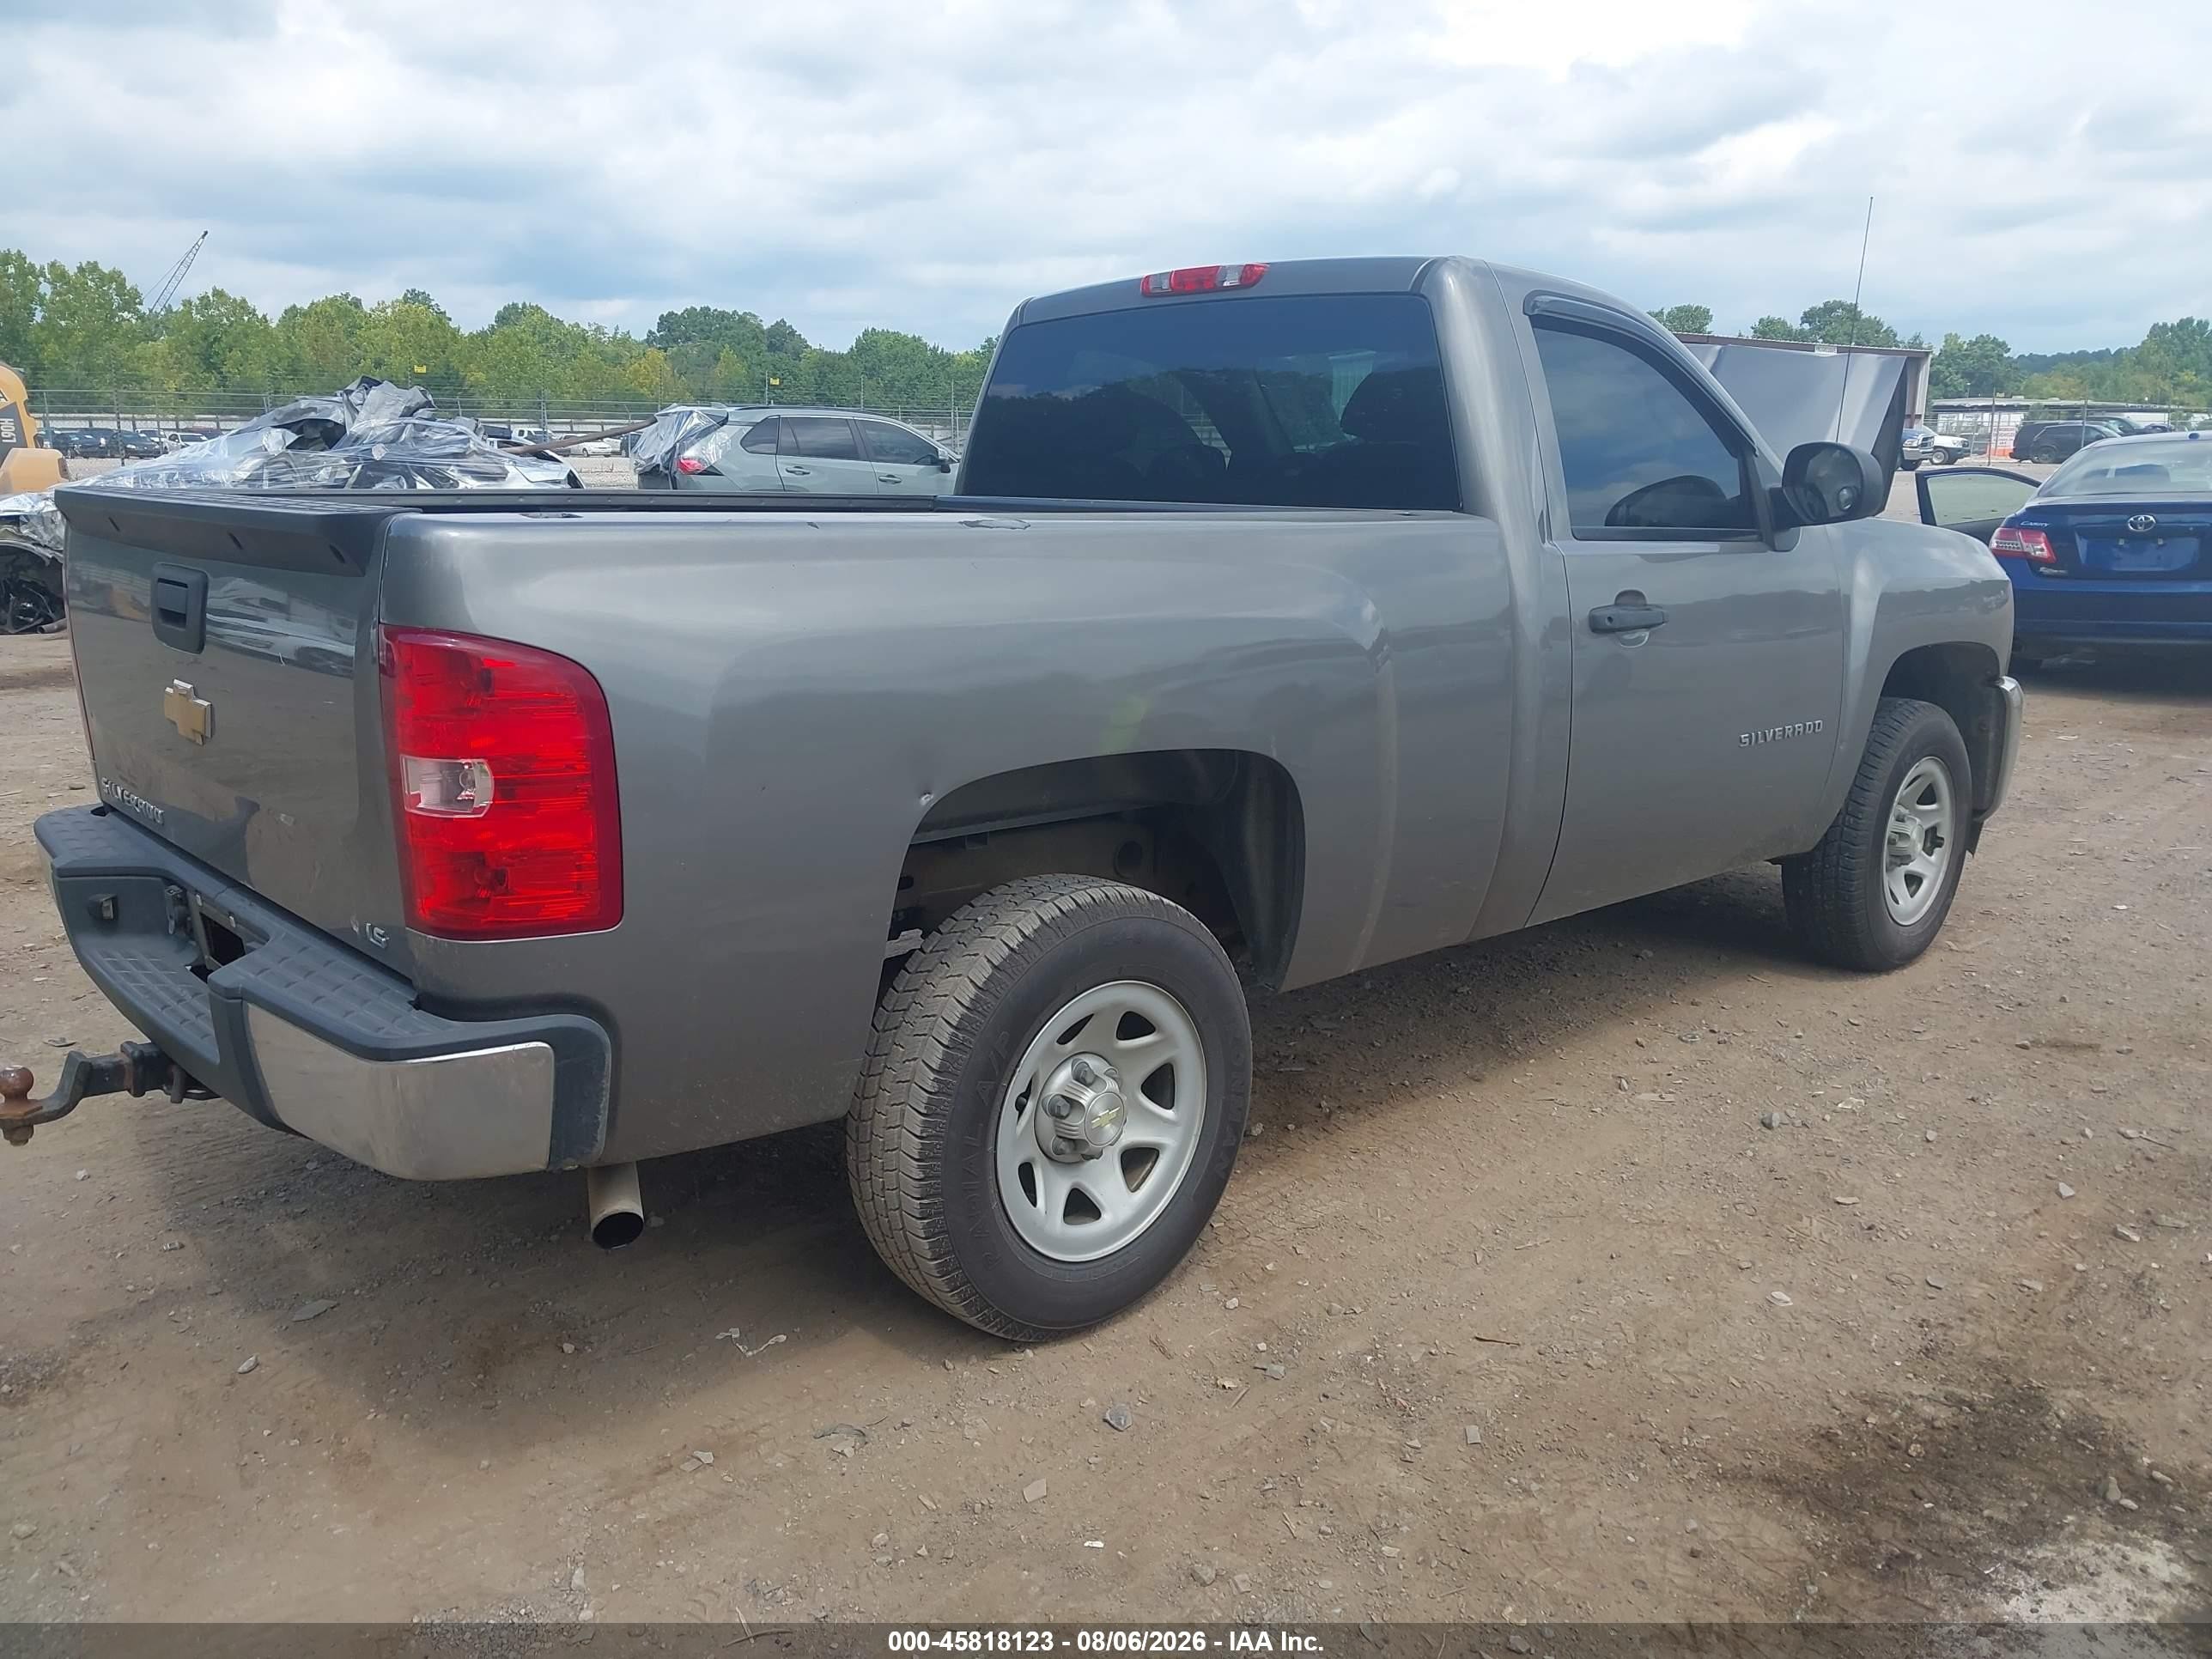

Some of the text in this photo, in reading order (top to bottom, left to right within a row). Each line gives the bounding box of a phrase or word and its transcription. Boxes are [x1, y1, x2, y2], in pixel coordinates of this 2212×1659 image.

[1739, 720, 1824, 748] SILVERADO
[101, 775, 165, 825] SILVERADO
[365, 922, 390, 949] LS
[961, 1122, 1002, 1273] RADIAL
